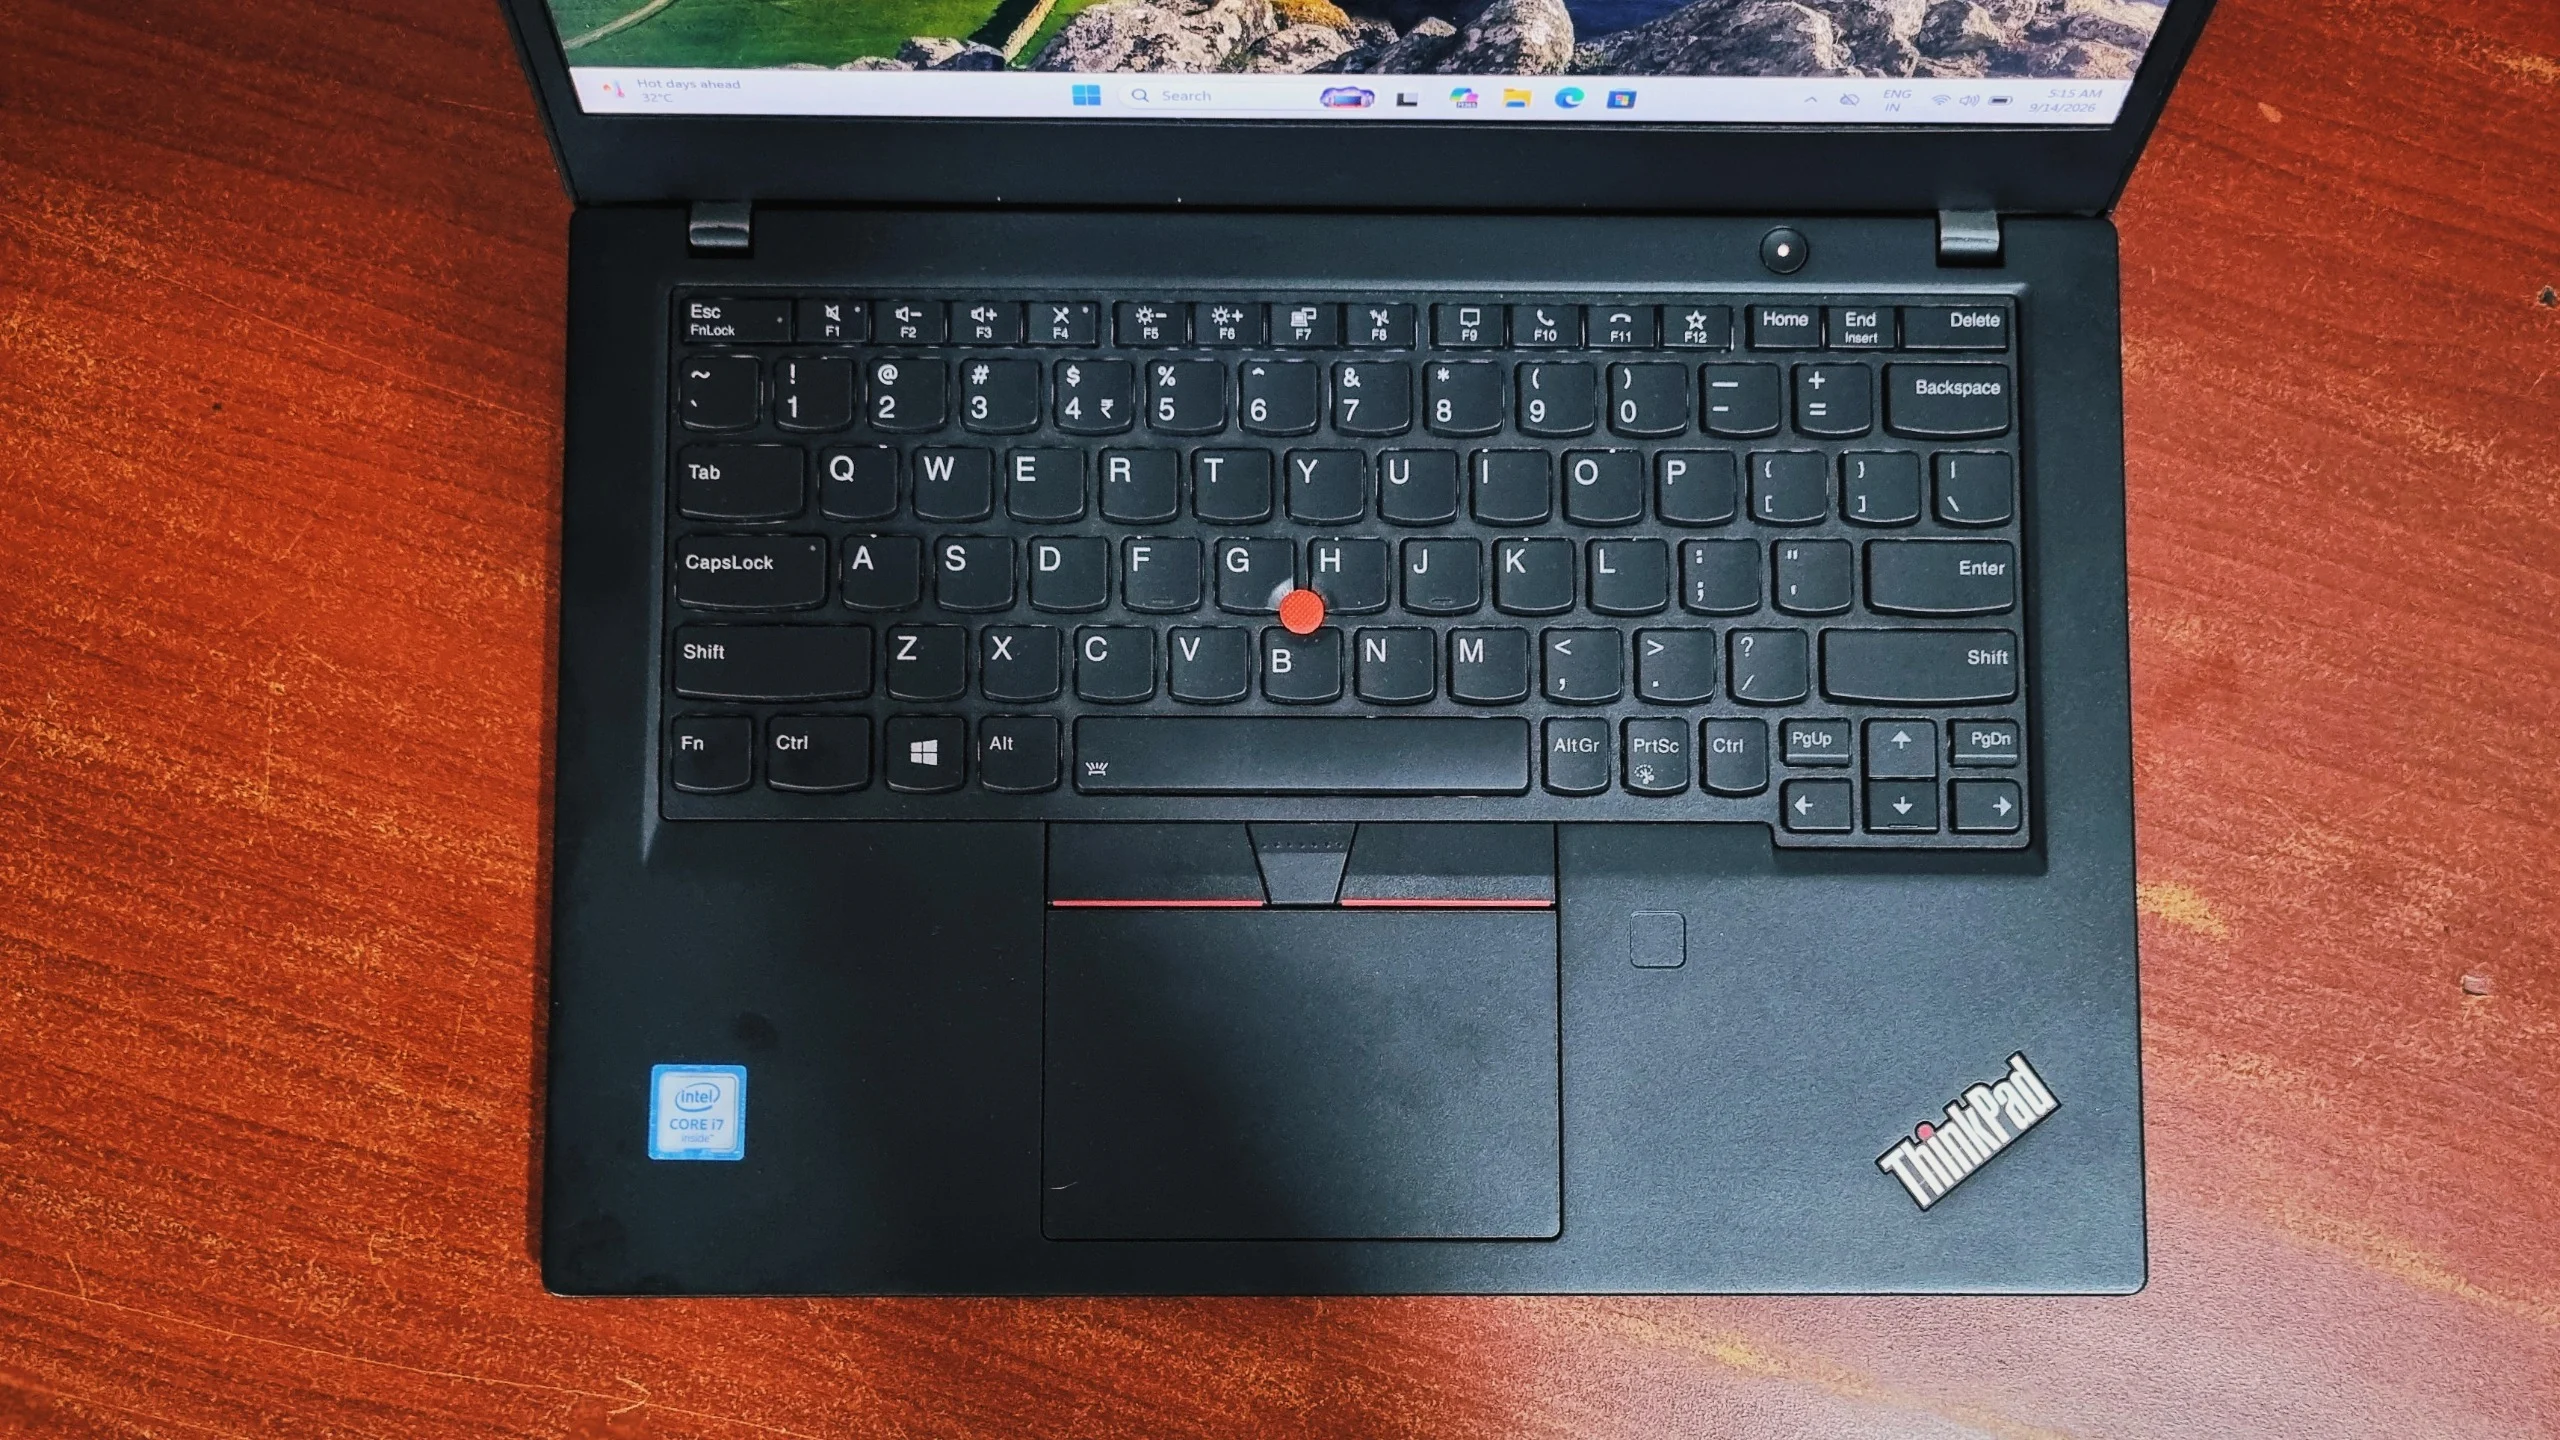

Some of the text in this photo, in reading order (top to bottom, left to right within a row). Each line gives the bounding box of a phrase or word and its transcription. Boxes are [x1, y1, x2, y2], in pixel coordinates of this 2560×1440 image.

[637, 78, 741, 91] Hot days ahead
[1883, 89, 1912, 99] ENG
[2079, 88, 2103, 99] AM
[1162, 90, 1212, 102] Search
[1885, 103, 1900, 112] IN
[690, 303, 722, 319] Esc
[1763, 310, 1809, 327] Home
[1845, 311, 1877, 327] End
[1950, 311, 2001, 328] Delete
[690, 323, 736, 336] FnLock
[825, 324, 840, 337] F1
[900, 325, 917, 339] F2
[976, 326, 993, 339] F3
[1053, 326, 1069, 340] F4
[1143, 326, 1160, 340] F5
[1219, 327, 1236, 340] F6
[1294, 327, 1312, 341] F7
[1370, 327, 1387, 341] F8
[1461, 328, 1477, 342] F9
[1533, 328, 1557, 342] F10
[1609, 329, 1632, 343] F11
[1683, 330, 1707, 344] F12
[1844, 331, 1878, 344] Insert
[877, 363, 899, 386] @
[971, 364, 990, 385] #
[1066, 364, 1081, 388] $
[1157, 365, 1176, 387] %
[1343, 367, 1361, 388] &
[1808, 370, 1826, 390] +
[1915, 379, 2001, 398] Backspace
[787, 395, 798, 418] 1
[878, 394, 896, 419] 2
[971, 395, 988, 420] 3
[1064, 396, 1082, 420] 4
[1158, 397, 1175, 421] 5
[1250, 397, 1267, 422] 6
[1343, 398, 1360, 422] 7
[1436, 398, 1452, 423] 8
[1529, 399, 1546, 423] 9
[1620, 399, 1637, 424] 0
[688, 463, 721, 480] Tab
[829, 455, 855, 483] Q
[923, 455, 955, 482] W
[1016, 455, 1036, 482] E
[1109, 457, 1131, 483] R
[1203, 457, 1224, 483] T
[1296, 458, 1318, 484] Y
[1389, 458, 1409, 485] U
[1482, 458, 1489, 484] I
[1574, 458, 1599, 486] O
[1667, 459, 1687, 485] P
[685, 554, 774, 574] CapsLock
[851, 545, 874, 571] A
[945, 544, 966, 572] S
[1039, 545, 1061, 572] D
[1132, 546, 1151, 572] F
[1226, 547, 1250, 573] G
[1320, 547, 1341, 573] H
[1413, 548, 1428, 574] J
[1506, 548, 1526, 574] K
[1599, 548, 1616, 574] L
[1959, 559, 2006, 576] Enter
[683, 643, 725, 660] Shift
[896, 635, 918, 661] Z
[991, 635, 1013, 661] X
[1085, 635, 1108, 662] C
[1179, 636, 1201, 662] V
[1366, 638, 1386, 663] N
[1459, 638, 1484, 663] M
[1740, 636, 1754, 658] ?
[1967, 649, 2009, 665] Shift
[1272, 648, 1292, 673] B
[681, 735, 704, 751] Fn
[776, 734, 809, 751] Ctrl
[989, 735, 1014, 751] Alt
[1633, 738, 1679, 754] PrtSc
[1712, 737, 1744, 753] Ctrl
[1792, 731, 1833, 749] PgUp
[1971, 731, 2012, 749] PgDn
[681, 1089, 713, 1104] intel
[669, 1118, 725, 1131] CORE i7
[1875, 1050, 2062, 1212] ThinkPad
